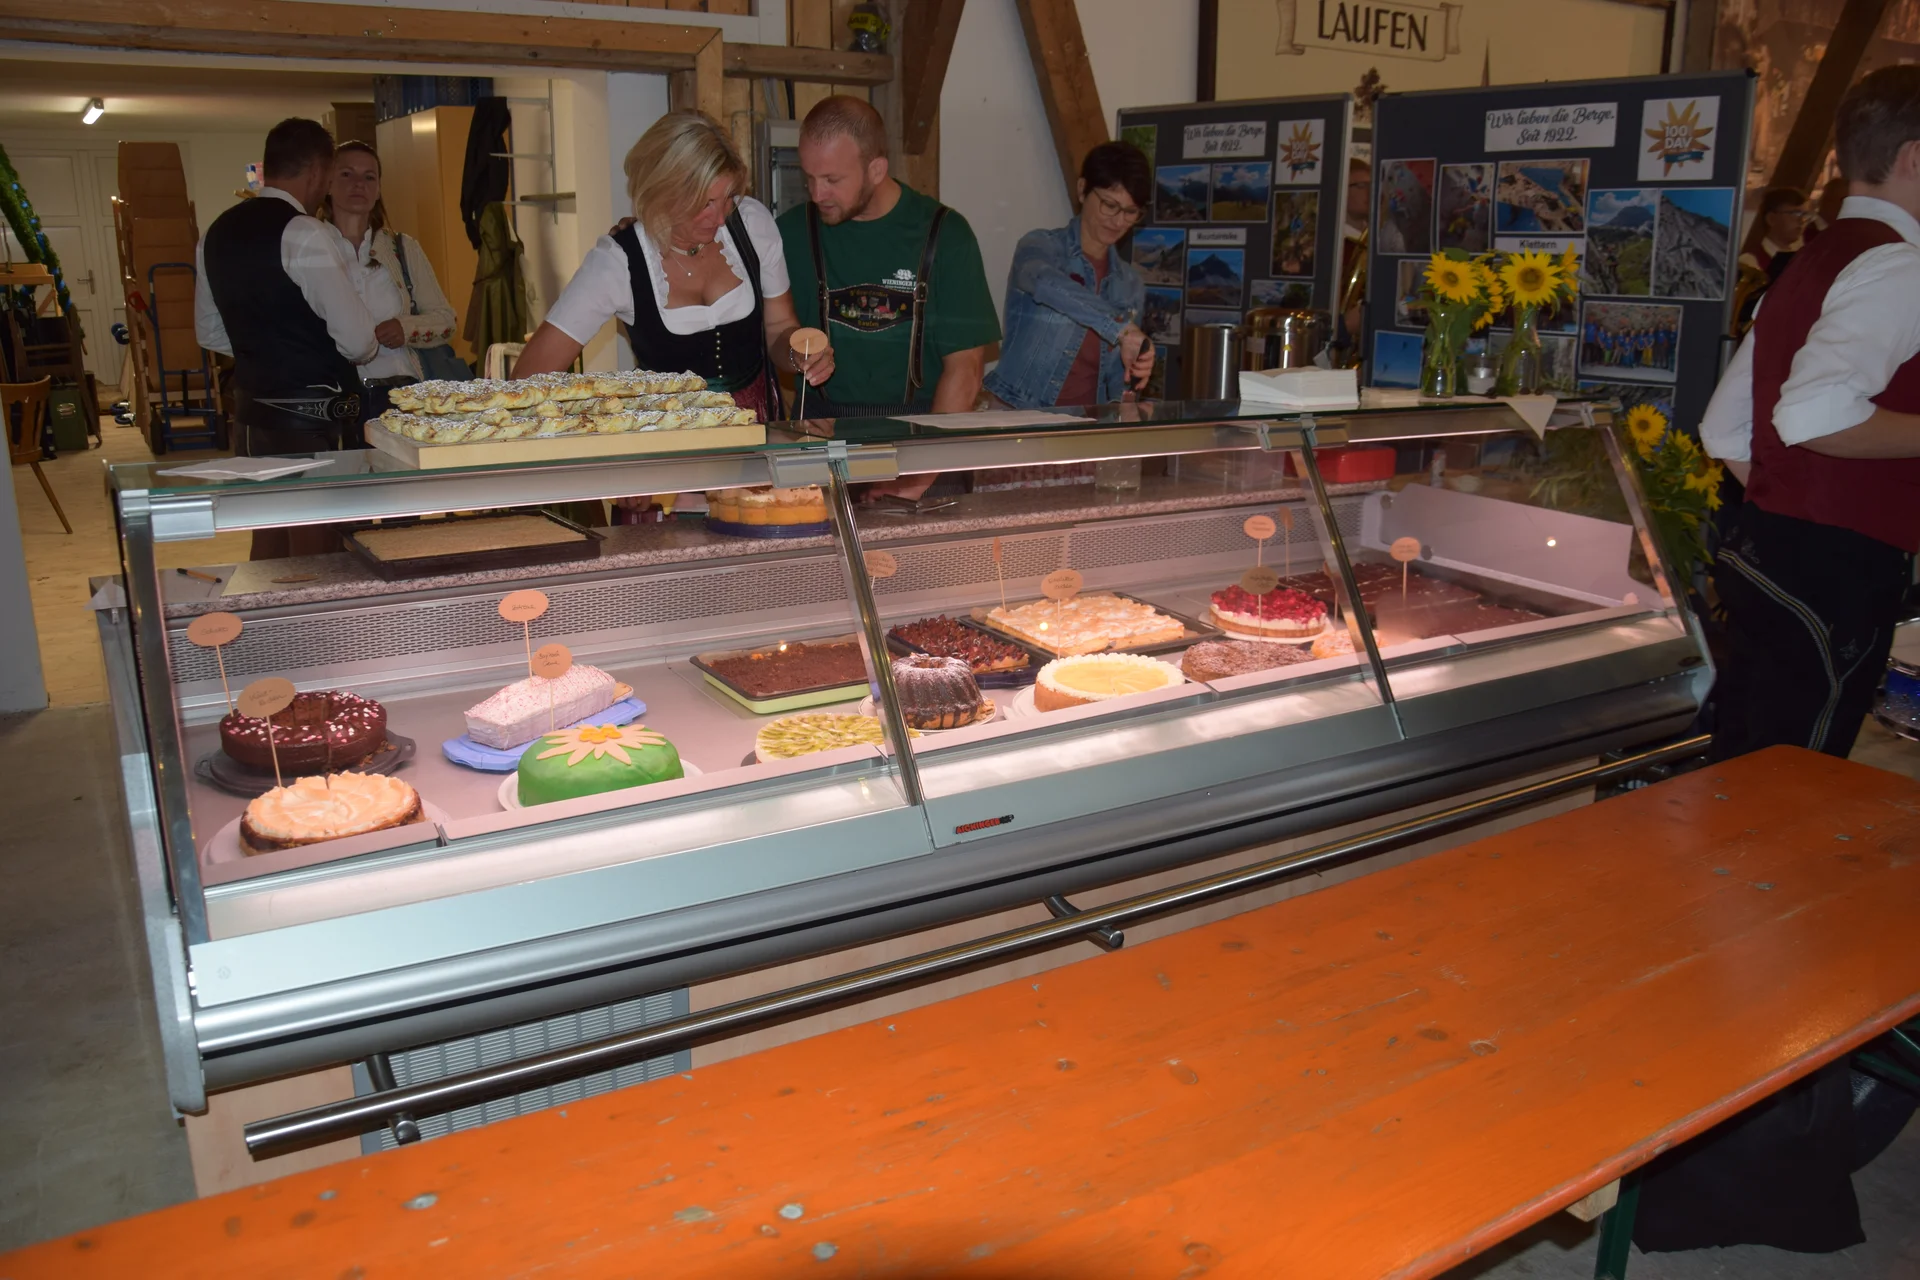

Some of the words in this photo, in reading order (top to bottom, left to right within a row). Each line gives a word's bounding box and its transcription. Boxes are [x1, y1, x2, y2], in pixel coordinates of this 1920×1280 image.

[1318, 0, 1428, 52] LAUFEN
[1487, 113, 1514, 129] Wir
[1517, 109, 1549, 125] lieben
[1551, 107, 1569, 123] die
[1572, 107, 1615, 124] Berge.
[1516, 128, 1541, 146] Seit
[1543, 126, 1578, 143] 1922.
[1665, 125, 1688, 137] 100
[1664, 136, 1693, 149] DAV
[1520, 240, 1557, 249] Klettern
[882, 278, 913, 287] WIENINGER
